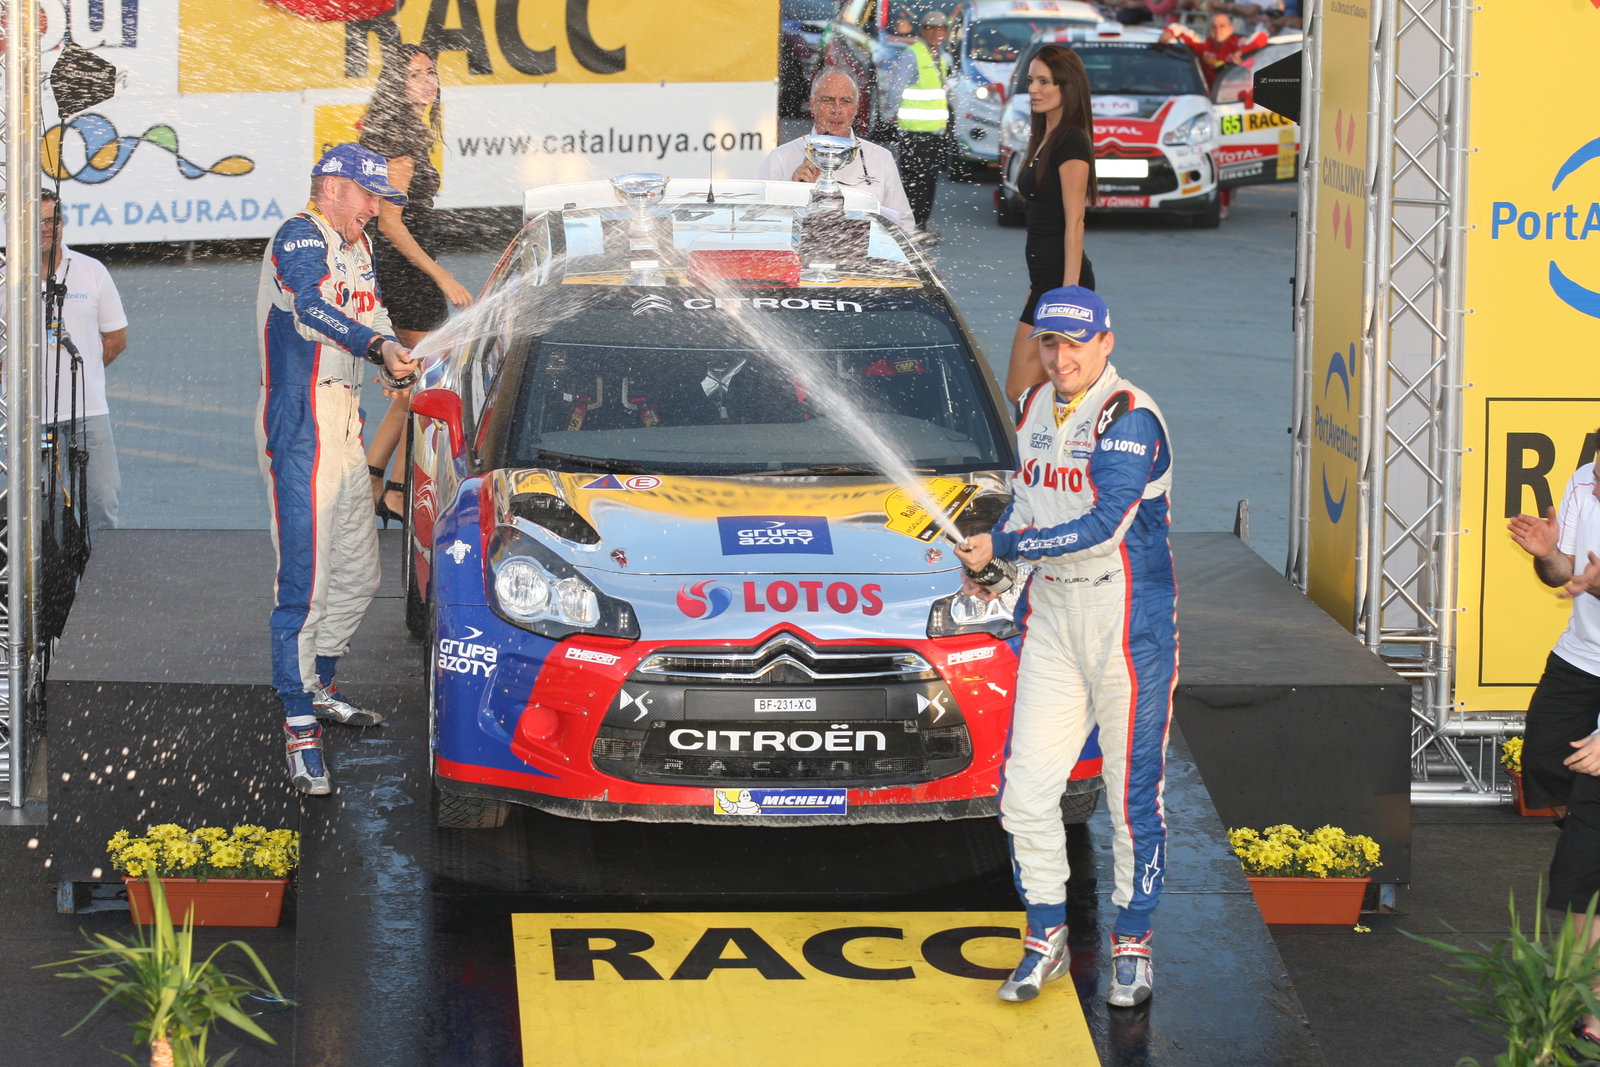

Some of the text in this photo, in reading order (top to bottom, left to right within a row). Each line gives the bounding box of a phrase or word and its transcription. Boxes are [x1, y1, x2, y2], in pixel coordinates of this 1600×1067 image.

[1092, 125, 1144, 136] OTAL
[1222, 116, 1242, 134] 65
[458, 128, 763, 160] www.catalunya.com
[1219, 148, 1263, 164] TOTAL
[123, 198, 285, 226] DAURADA
[296, 238, 326, 249] LOTOS
[1047, 306, 1090, 319] MICHELIN
[1114, 440, 1147, 456] LOTOS
[742, 580, 884, 616] LOTOS
[759, 699, 812, 710] BF-231-XC
[669, 723, 886, 752] CITROËN
[762, 795, 846, 806] MICHELIN
[551, 925, 1022, 981] RACC
